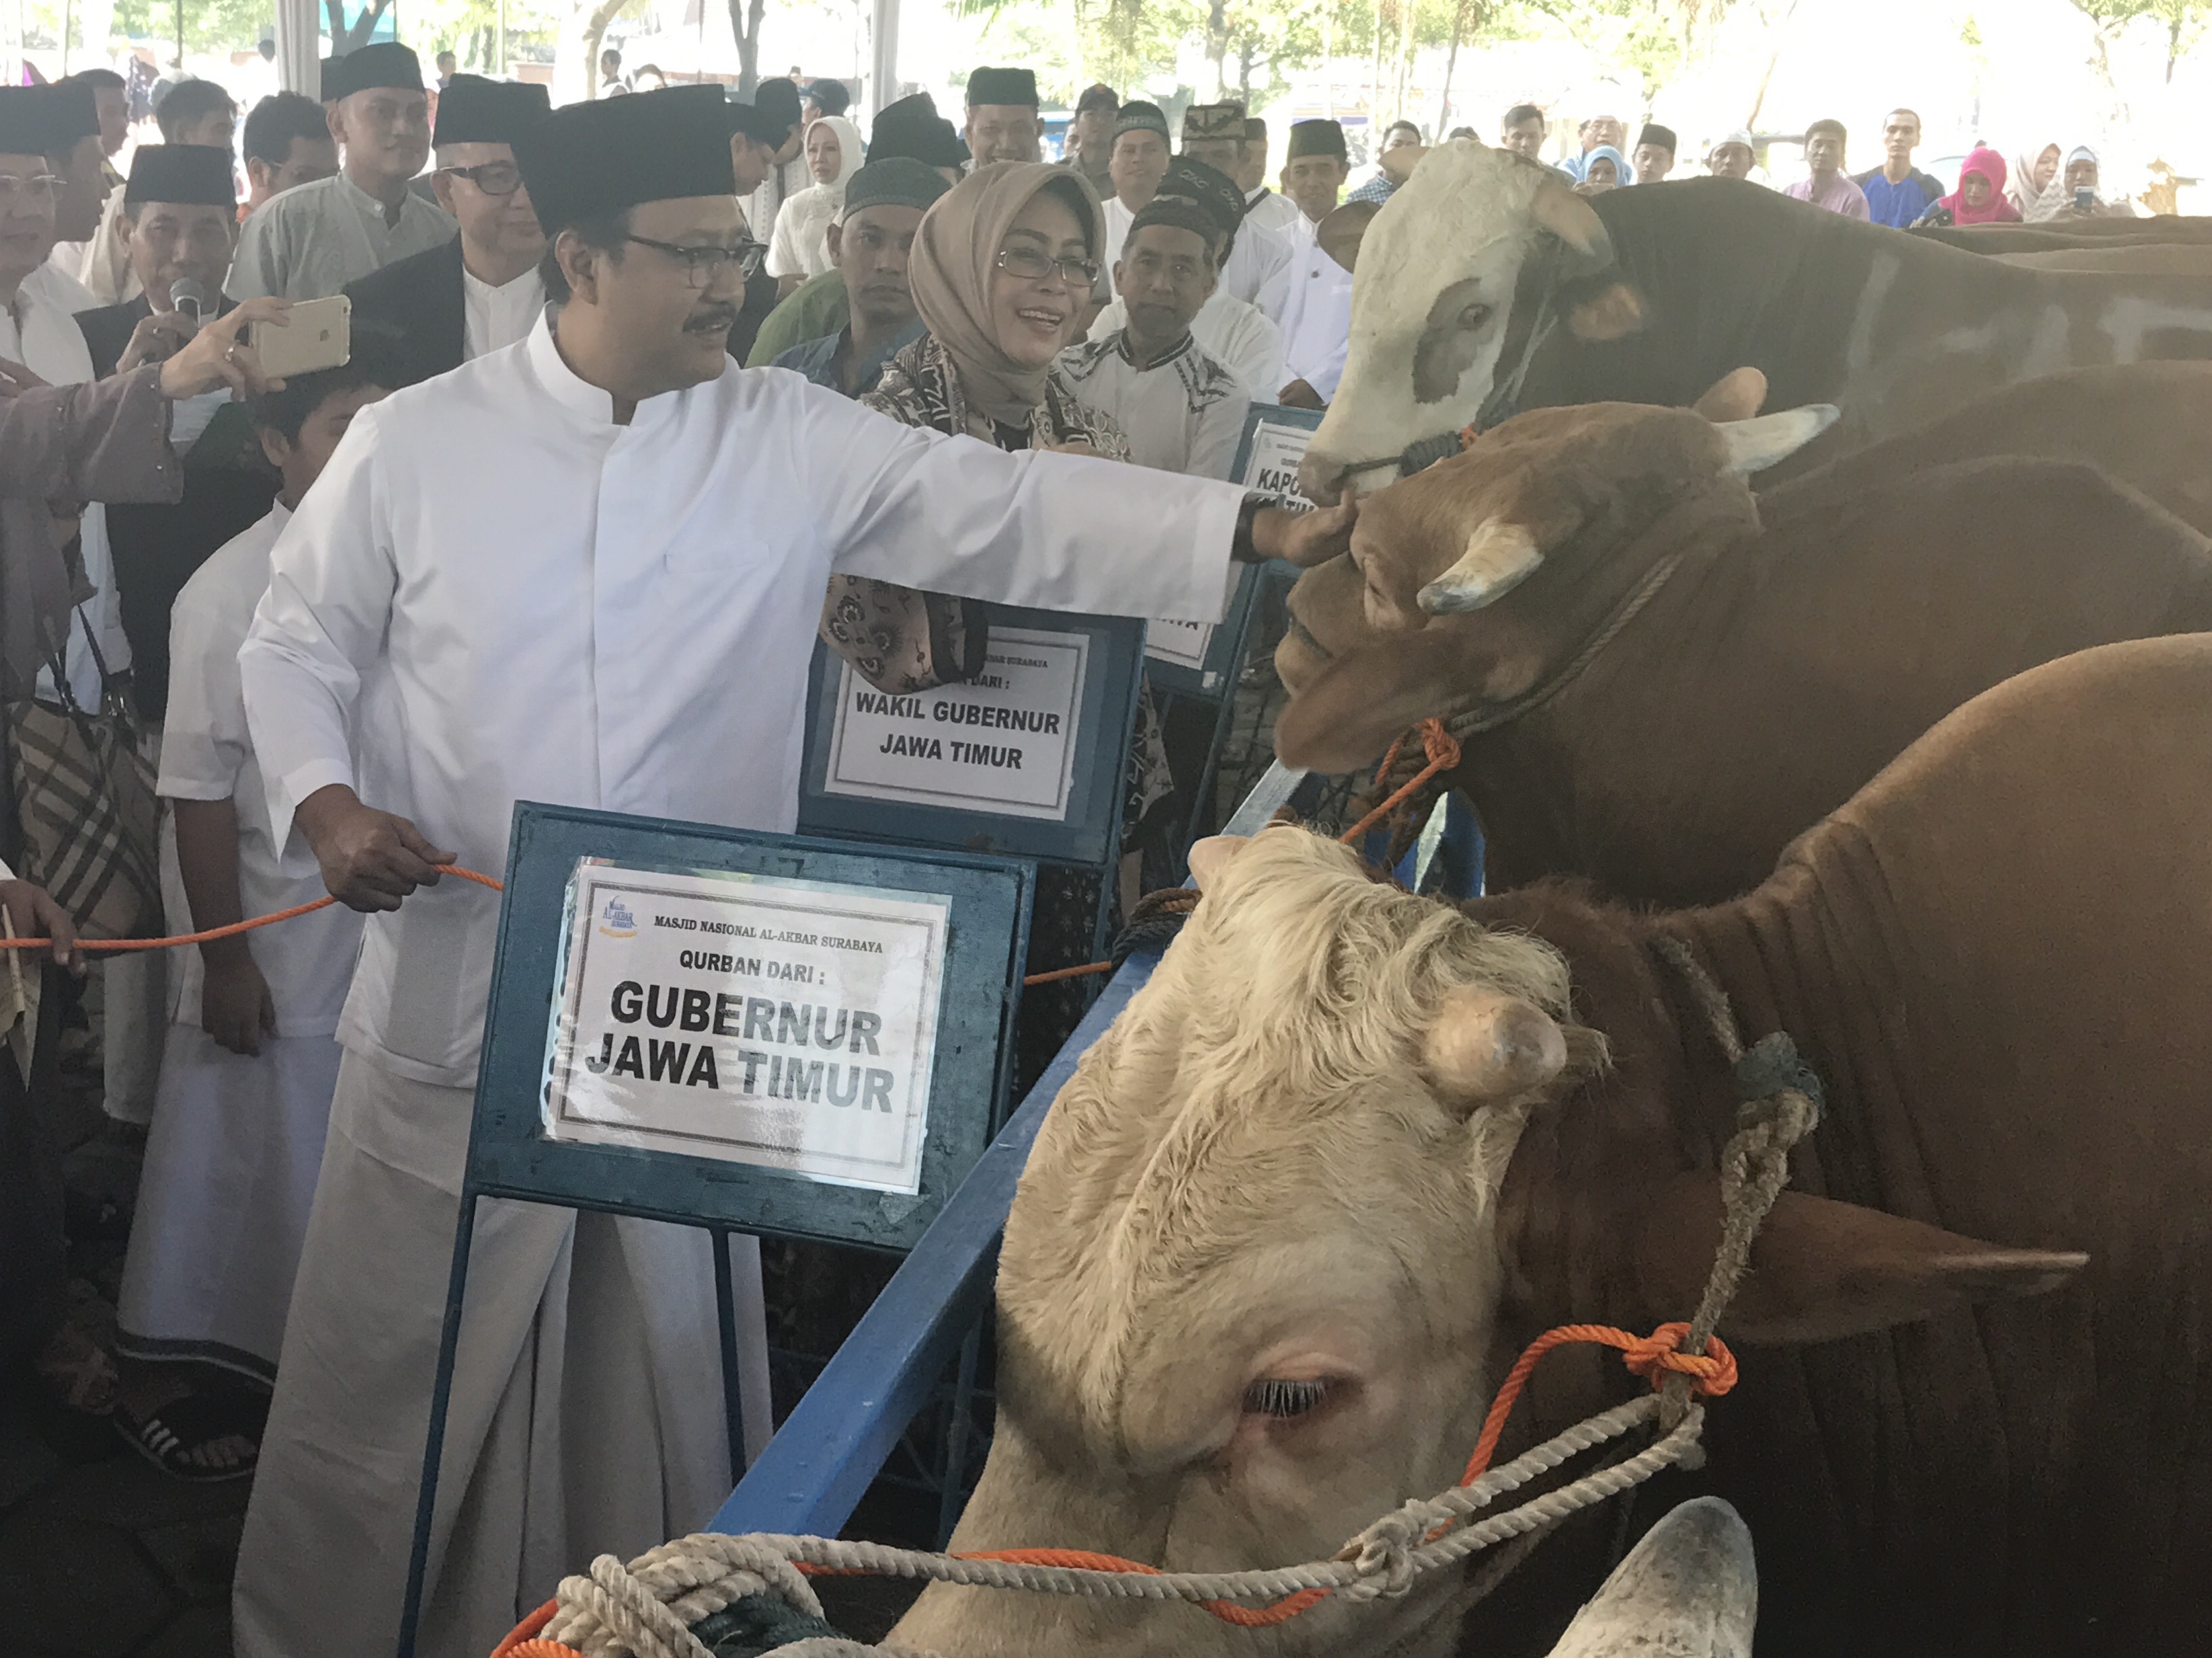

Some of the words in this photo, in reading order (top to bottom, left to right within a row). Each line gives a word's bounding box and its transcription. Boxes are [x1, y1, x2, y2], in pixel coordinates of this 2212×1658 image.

[1257, 468, 1300, 496] KAPO
[856, 692, 926, 719] WAKIL
[933, 701, 1060, 734] GUBERNUR
[880, 734, 943, 760] JAWA
[950, 741, 1023, 770] TIMUR
[654, 916, 697, 931] MASJID
[699, 920, 756, 938] NASIONAL
[759, 929, 818, 946] AL-AKBAR
[821, 936, 883, 954] SURABAYA
[680, 949, 761, 976] QURBAN
[766, 961, 814, 984] DARI
[610, 980, 882, 1056] GUBERNUR
[585, 1033, 719, 1089] JAWA
[738, 1049, 895, 1113] TIMUR
